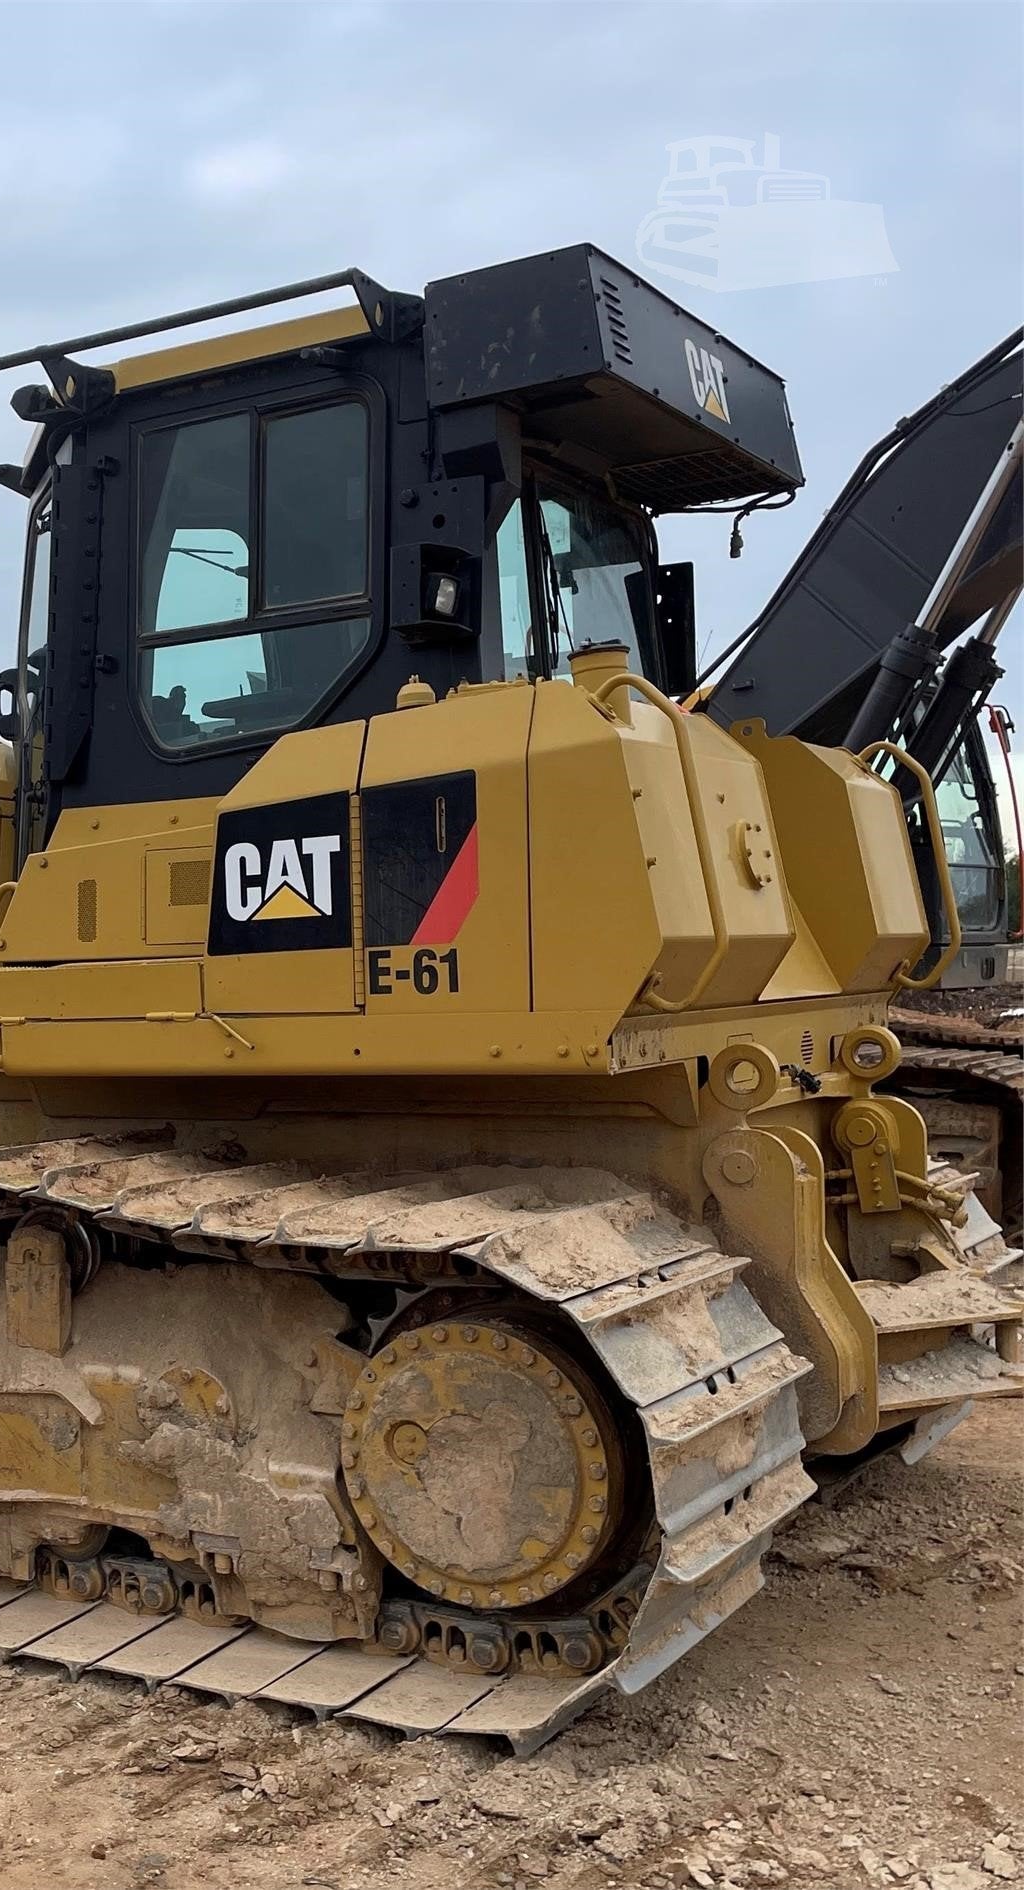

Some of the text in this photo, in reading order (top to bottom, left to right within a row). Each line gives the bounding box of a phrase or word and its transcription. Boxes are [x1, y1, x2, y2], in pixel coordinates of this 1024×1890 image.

[684, 338, 731, 424] CAT
[224, 834, 341, 922] CAT
[368, 948, 459, 995] E-61
